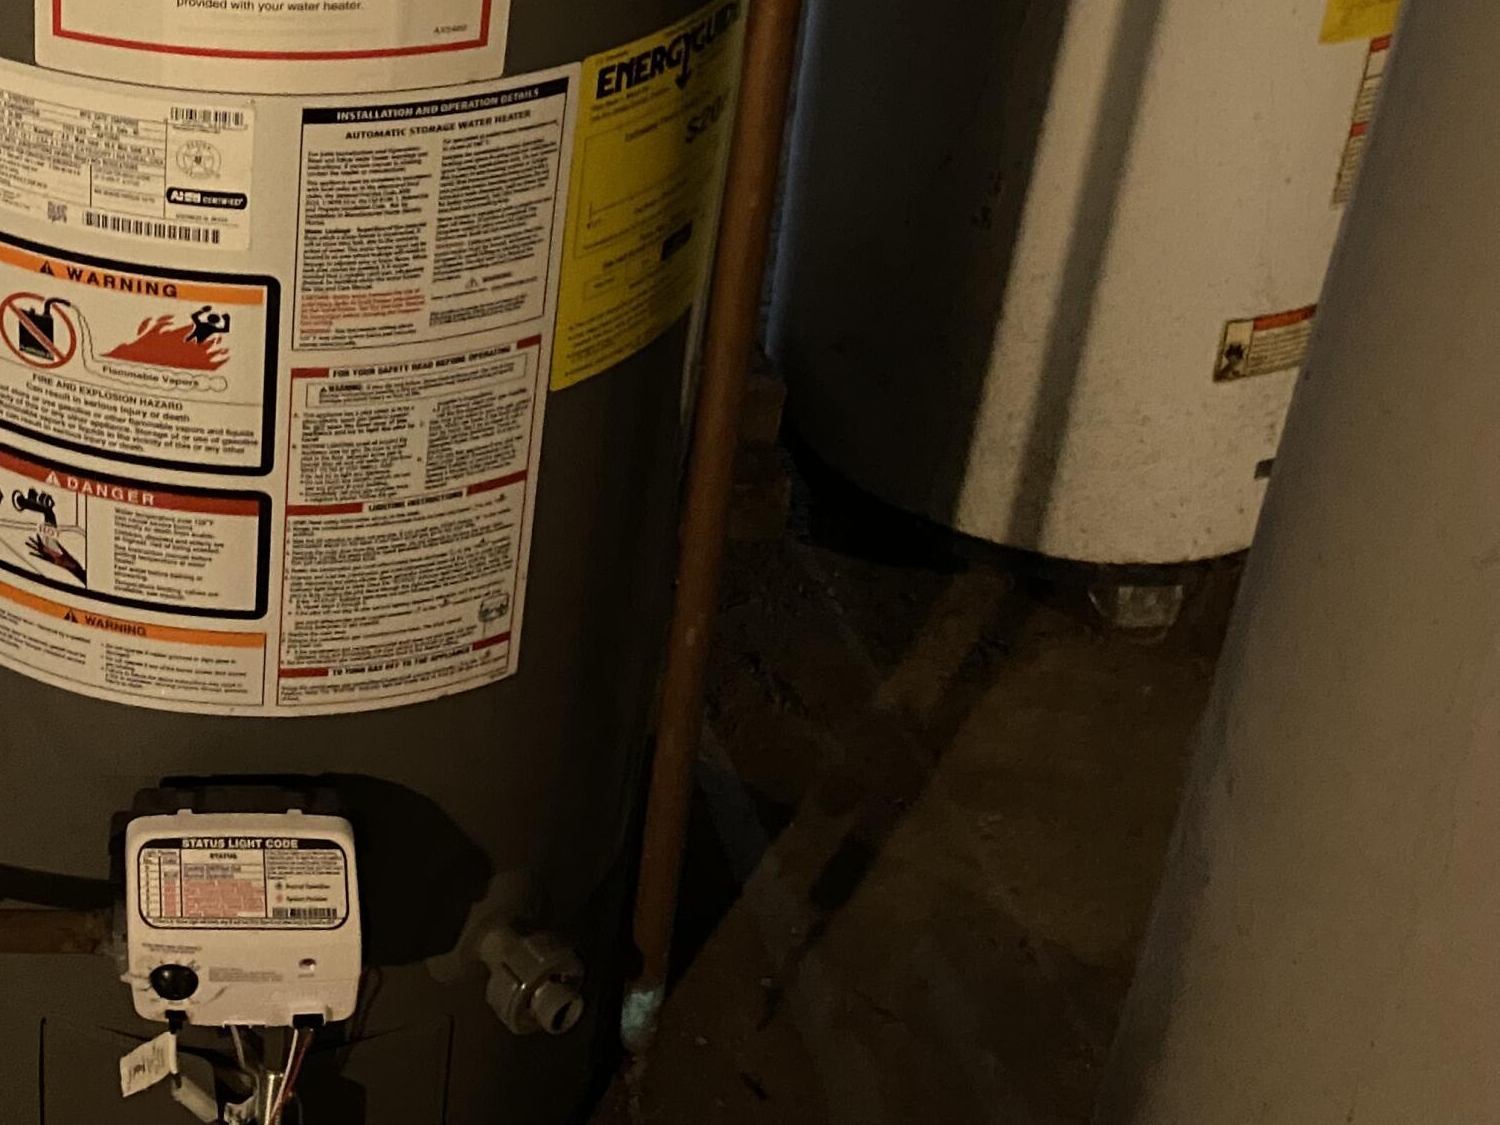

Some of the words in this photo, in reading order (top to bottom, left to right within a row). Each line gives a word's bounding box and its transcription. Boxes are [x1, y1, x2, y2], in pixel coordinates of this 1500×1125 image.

[230, 1, 254, 10] with
[258, 2, 284, 13] your
[287, 2, 319, 11] water
[336, 106, 414, 122] INSTALLATION
[415, 104, 439, 117] AND
[440, 96, 498, 114] OPERATION
[500, 88, 539, 104] DETAILS
[345, 128, 406, 140] AUTOMATIC
[409, 122, 455, 135] STORAGE
[458, 116, 492, 130] WATER
[494, 109, 530, 123] HEATER
[66, 265, 178, 298] WARNING
[33, 373, 54, 386] FIRE
[56, 381, 77, 392] AND
[79, 386, 137, 404] EXPLOSION
[140, 396, 183, 411] HAZARD
[67, 475, 154, 506] DANGER
[84, 614, 147, 637] WARNING
[182, 839, 225, 849] STATUS
[228, 839, 263, 849] LIGHT
[265, 839, 299, 849] CODE
